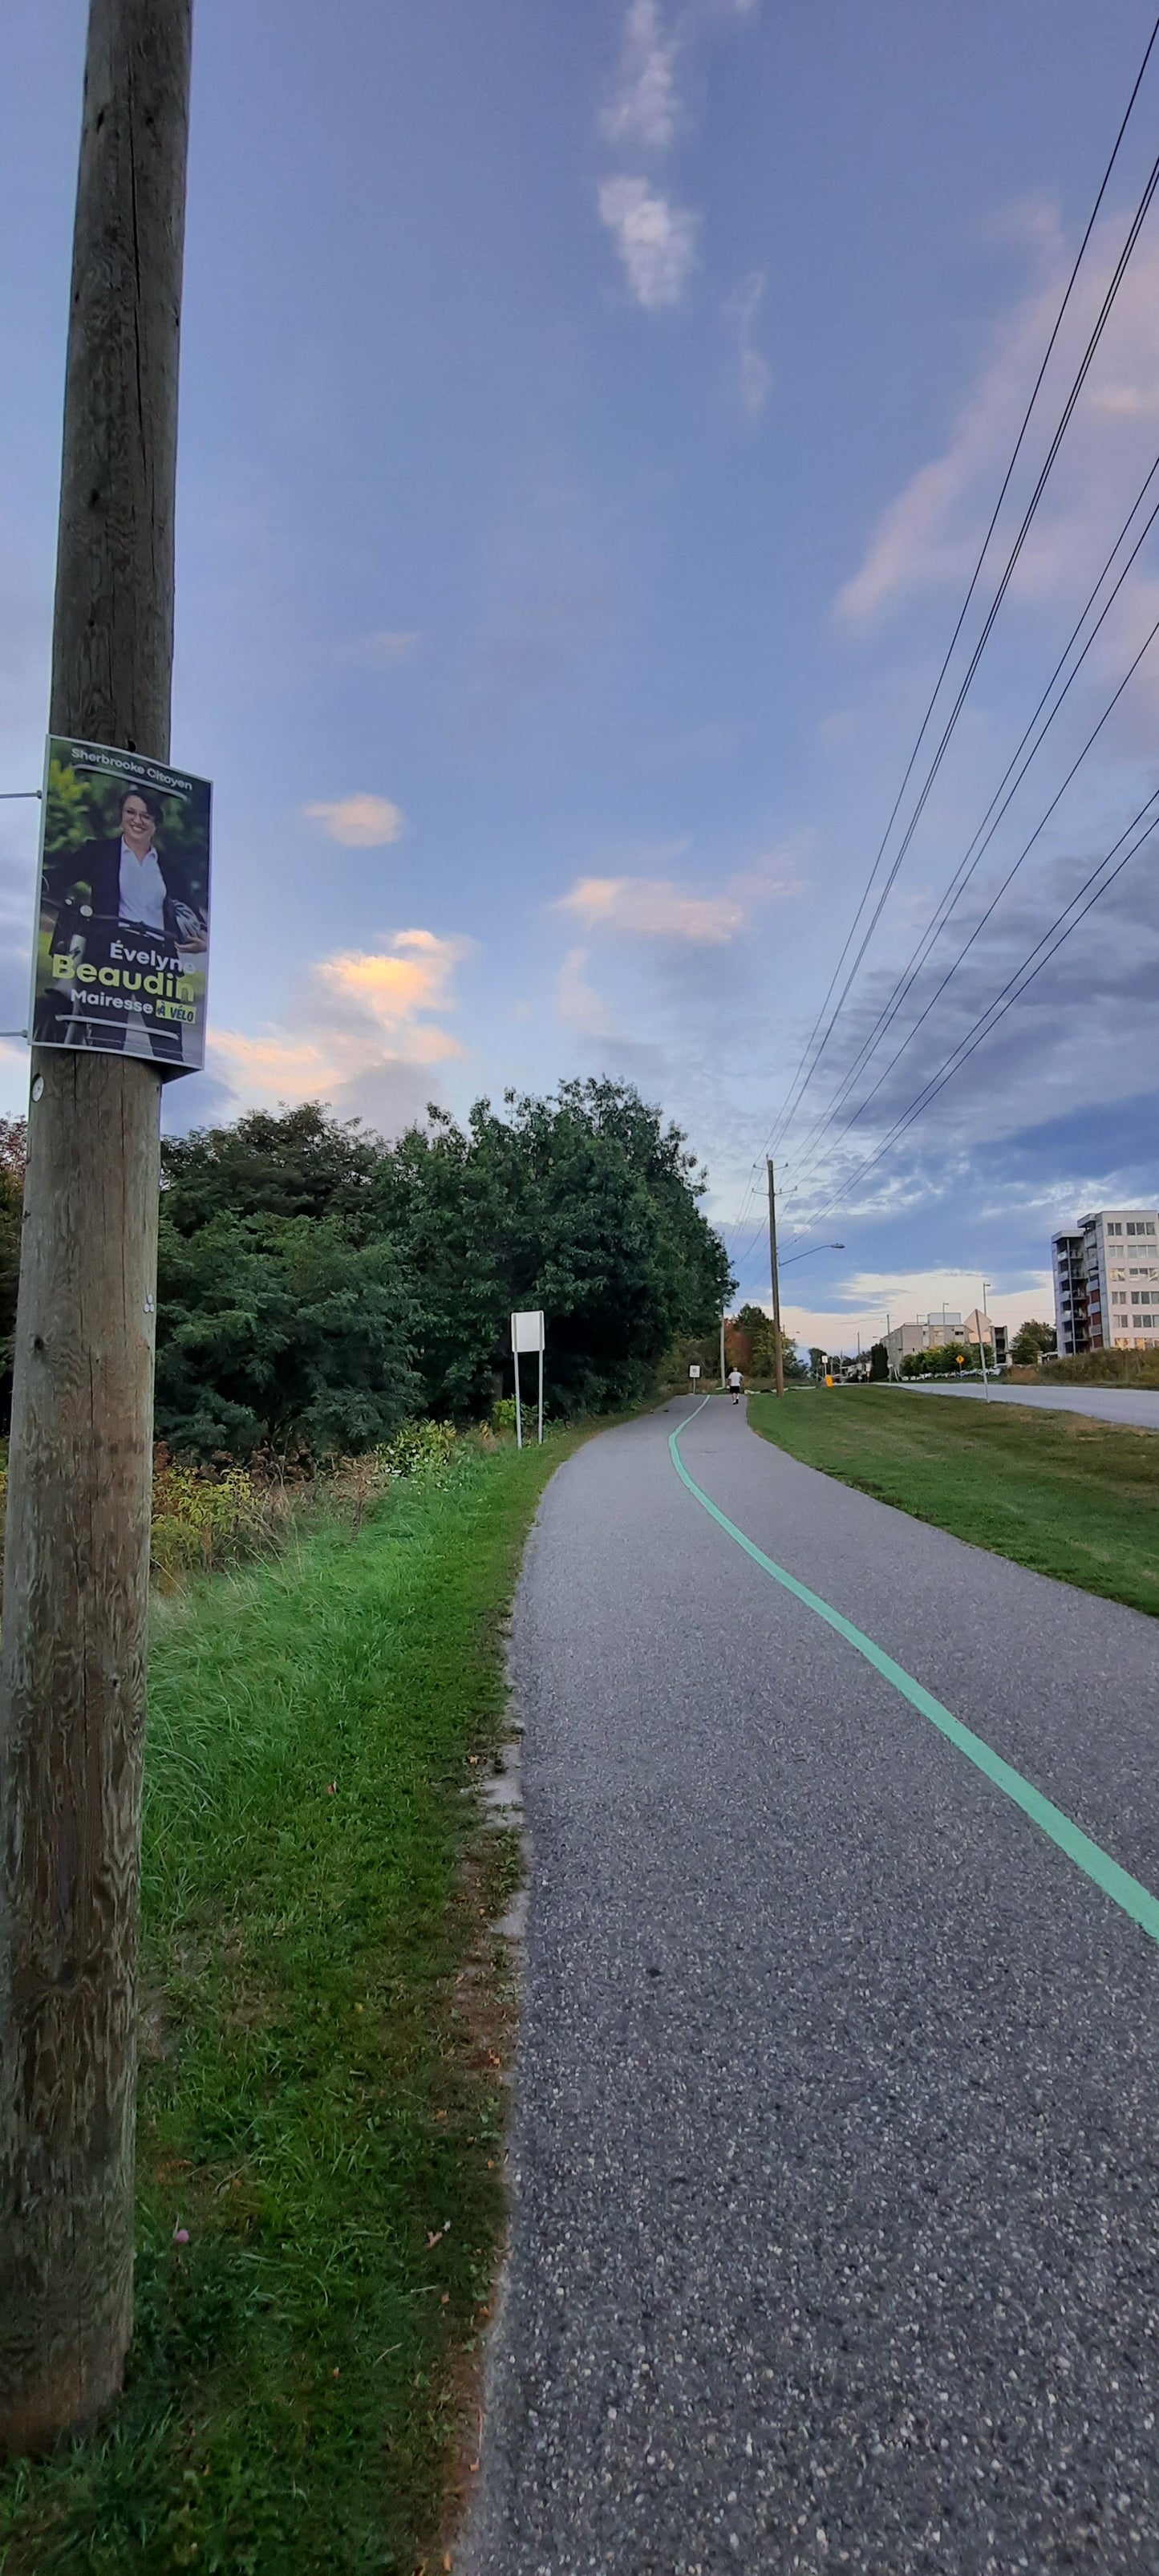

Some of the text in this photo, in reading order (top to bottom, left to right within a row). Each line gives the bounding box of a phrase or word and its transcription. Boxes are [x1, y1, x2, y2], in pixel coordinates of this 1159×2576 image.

[71, 748, 192, 791] Sherbrooke Citoyen
[109, 939, 196, 974] Évelyne
[52, 954, 195, 1002] Beaudin
[71, 988, 194, 1022] Mairesse À VÉLO
